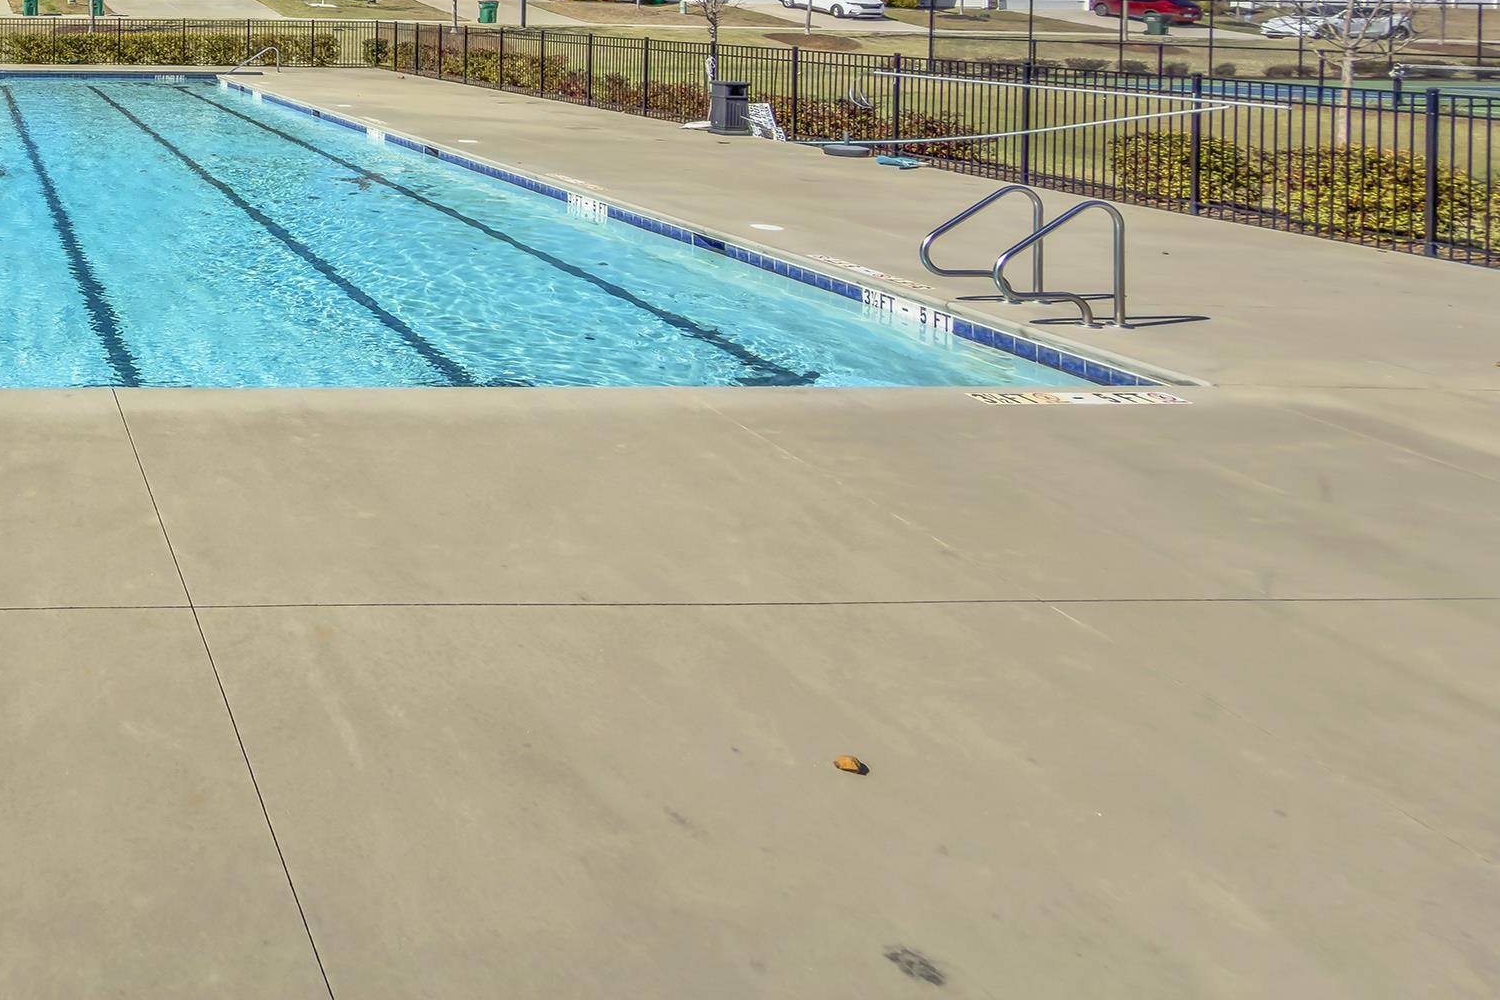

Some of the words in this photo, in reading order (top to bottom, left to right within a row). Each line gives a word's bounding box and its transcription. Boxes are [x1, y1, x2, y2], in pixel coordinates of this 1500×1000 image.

[920, 306, 927, 324] 5
[934, 311, 951, 332] FT
[1092, 393, 1120, 403] 5
[1113, 393, 1155, 403] FT
